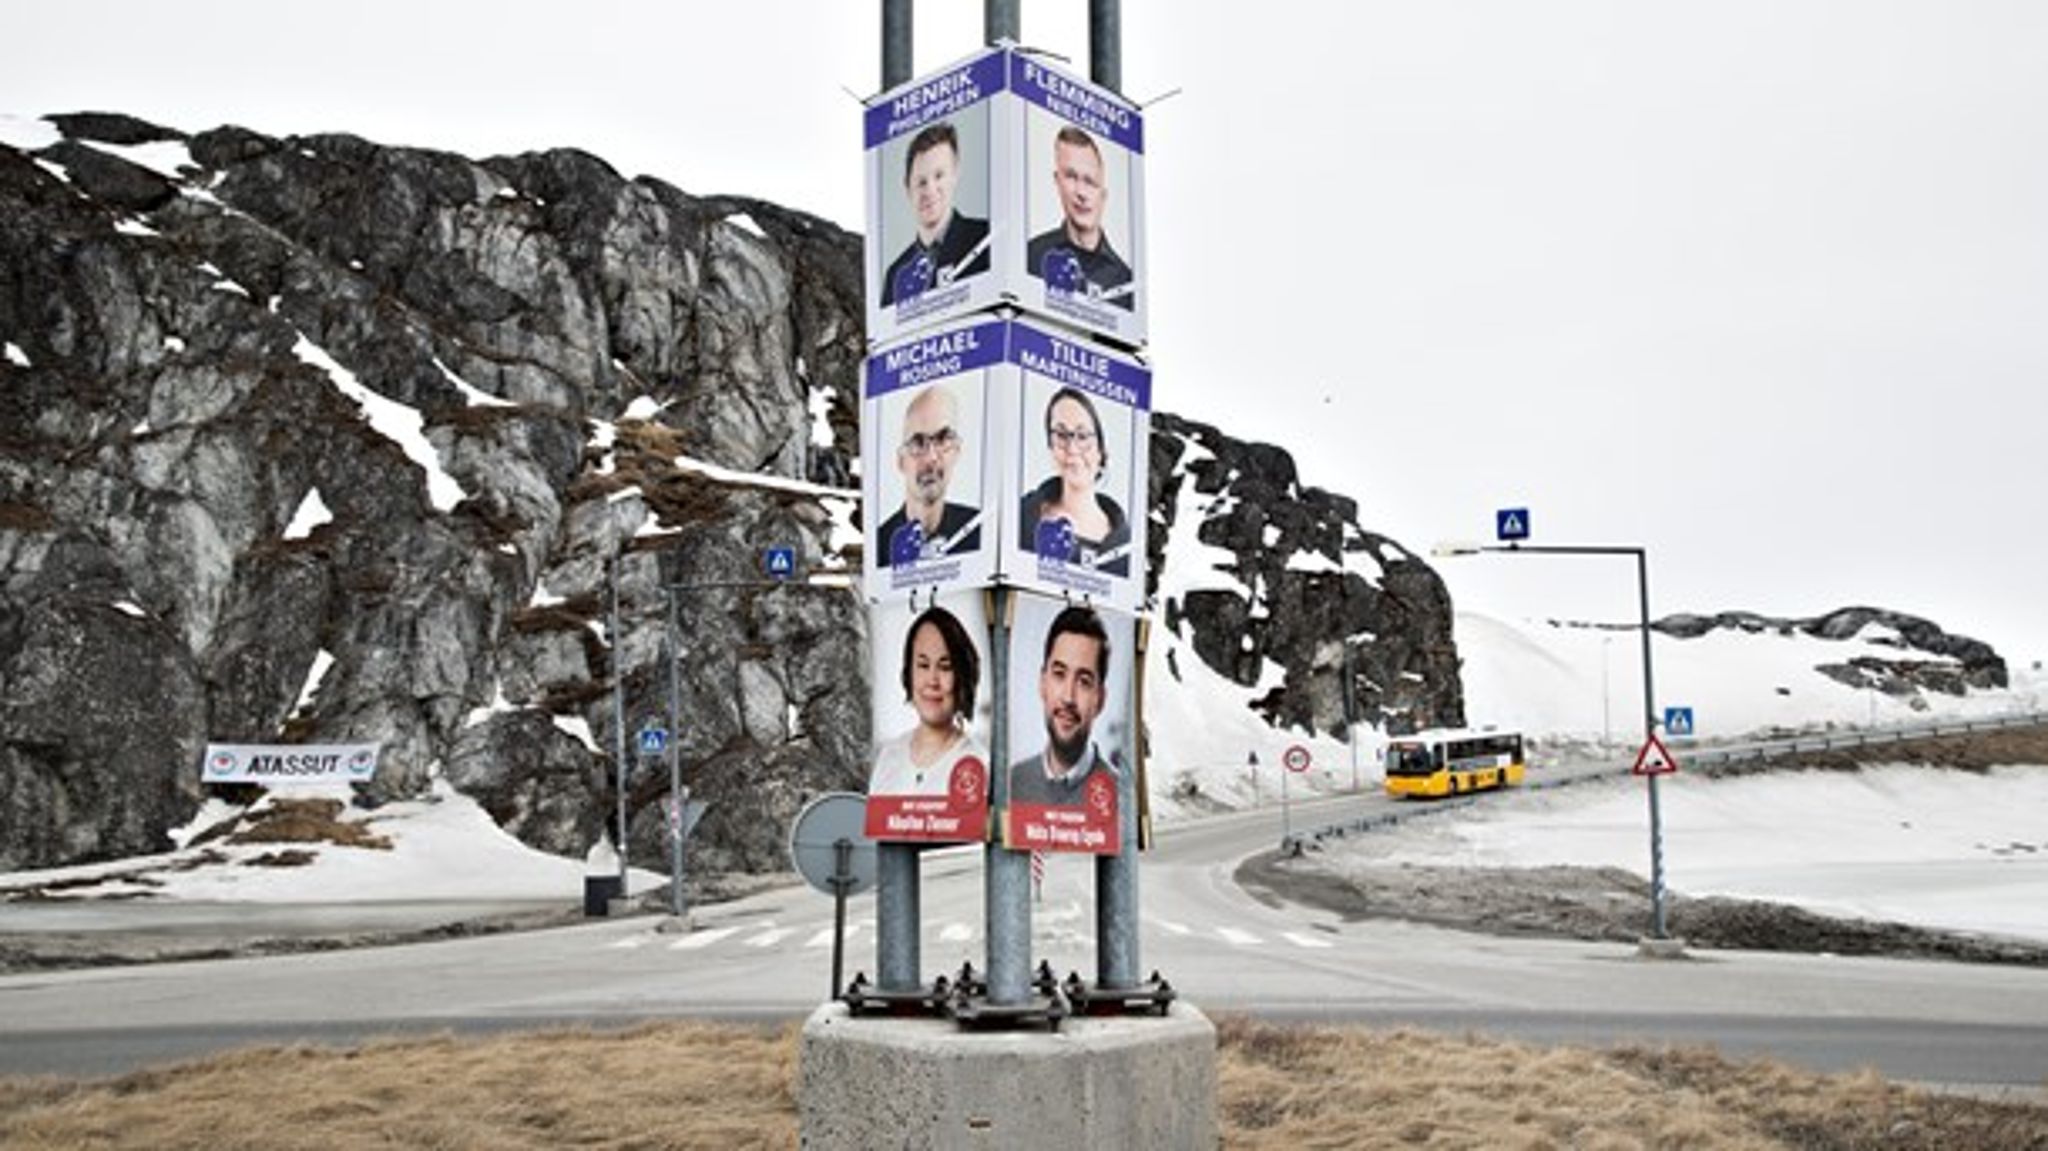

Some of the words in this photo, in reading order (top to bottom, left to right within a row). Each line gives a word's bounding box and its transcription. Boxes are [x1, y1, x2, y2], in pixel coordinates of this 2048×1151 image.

[893, 66, 976, 119] HENRIK
[1025, 62, 1129, 129] FLEMMING
[1046, 93, 1111, 136] NIELSEN
[885, 329, 980, 373] MICHAEL
[1050, 338, 1109, 378] TILLIE
[1020, 349, 1138, 405] MARTINUSSEN
[247, 753, 341, 776] ATASSUT
